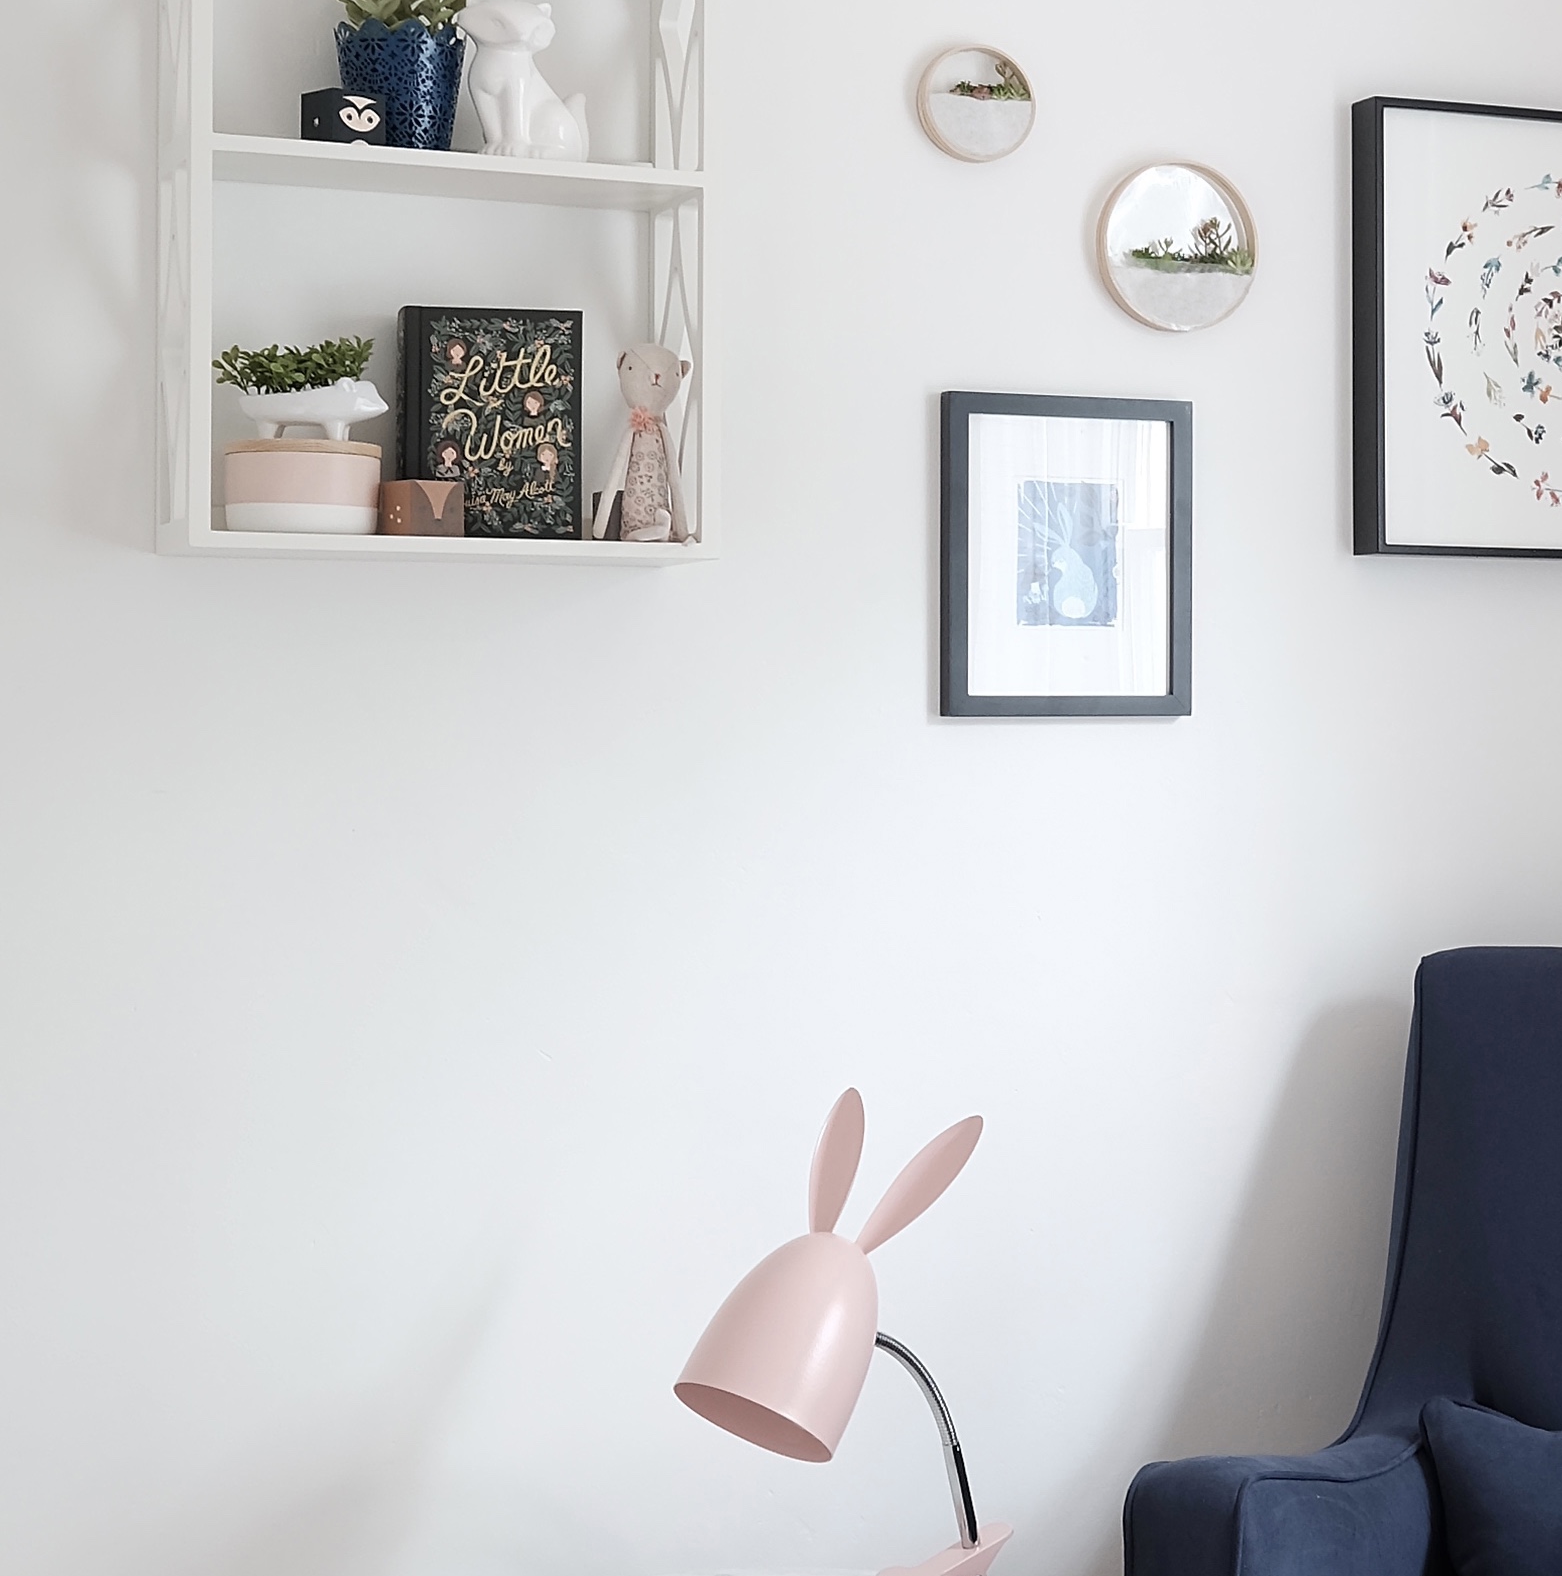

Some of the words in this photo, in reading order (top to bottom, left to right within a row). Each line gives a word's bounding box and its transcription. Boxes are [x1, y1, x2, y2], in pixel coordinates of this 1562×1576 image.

[440, 344, 560, 407] Little
[441, 408, 572, 462] Women
[496, 457, 514, 477] by
[464, 494, 487, 508] uisa
[486, 487, 519, 509] May
[516, 478, 557, 500] Alcott
